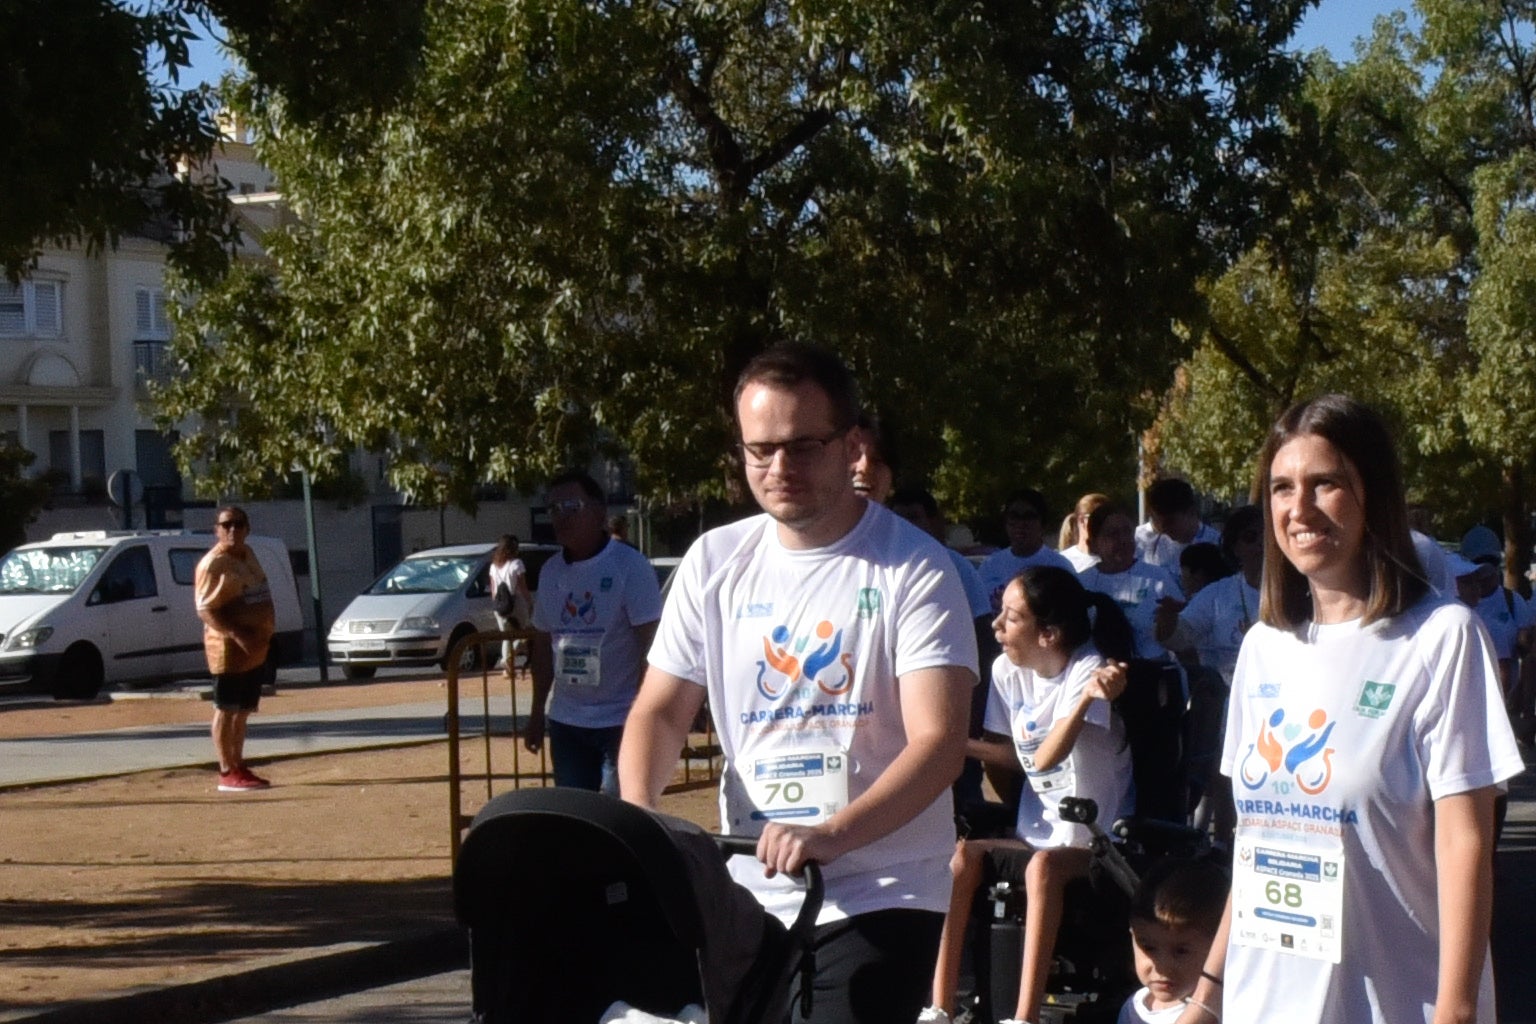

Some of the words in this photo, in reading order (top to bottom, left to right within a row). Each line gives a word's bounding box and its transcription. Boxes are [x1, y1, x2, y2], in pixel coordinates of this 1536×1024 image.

[764, 781, 804, 805] 70
[1236, 799, 1359, 825] RRERA-MARCHA
[1265, 880, 1302, 908] 68
